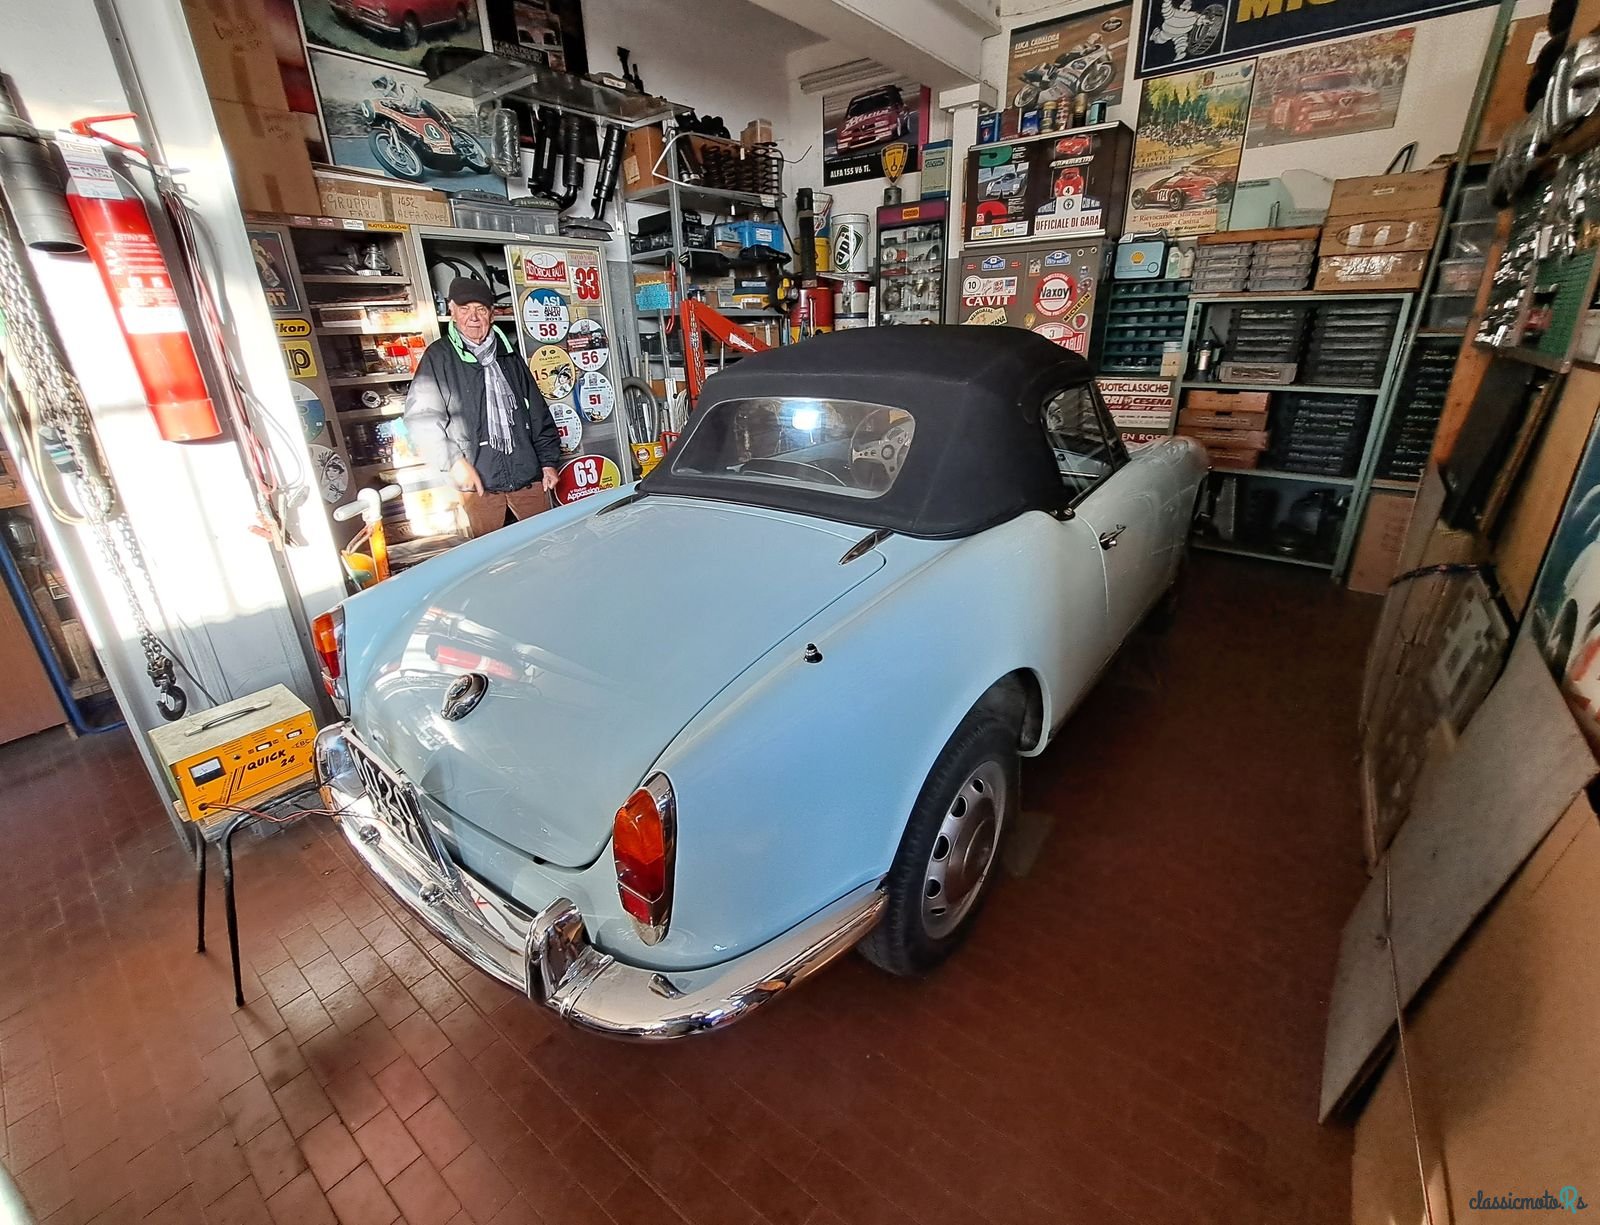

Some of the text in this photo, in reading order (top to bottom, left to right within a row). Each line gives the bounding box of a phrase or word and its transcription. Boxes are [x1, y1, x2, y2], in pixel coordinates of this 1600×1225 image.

[1014, 41, 1029, 51] LUCA
[429, 124, 441, 139] 8
[830, 168, 844, 179] ALFA
[844, 167, 854, 176] 155
[854, 166, 863, 175] V6
[327, 194, 372, 216] GRUPPI
[1035, 215, 1099, 231] UFFICIALE DI GARA
[1139, 212, 1179, 222] Rievocazione
[526, 262, 565, 277] HISTORICAL RALLY
[575, 267, 600, 300] 33
[968, 281, 976, 290] 10
[1038, 286, 1072, 299] Waxoyl
[543, 296, 560, 306] ASI
[1064, 293, 1090, 322] MICHELIN
[538, 323, 557, 337] 58
[581, 351, 599, 365] 56
[534, 369, 549, 381] 15
[588, 394, 602, 405] 51
[556, 426, 569, 437] 51
[1121, 433, 1135, 441] EN
[573, 459, 598, 488] 63
[247, 749, 286, 771] QUICK
[280, 755, 296, 768] 24
